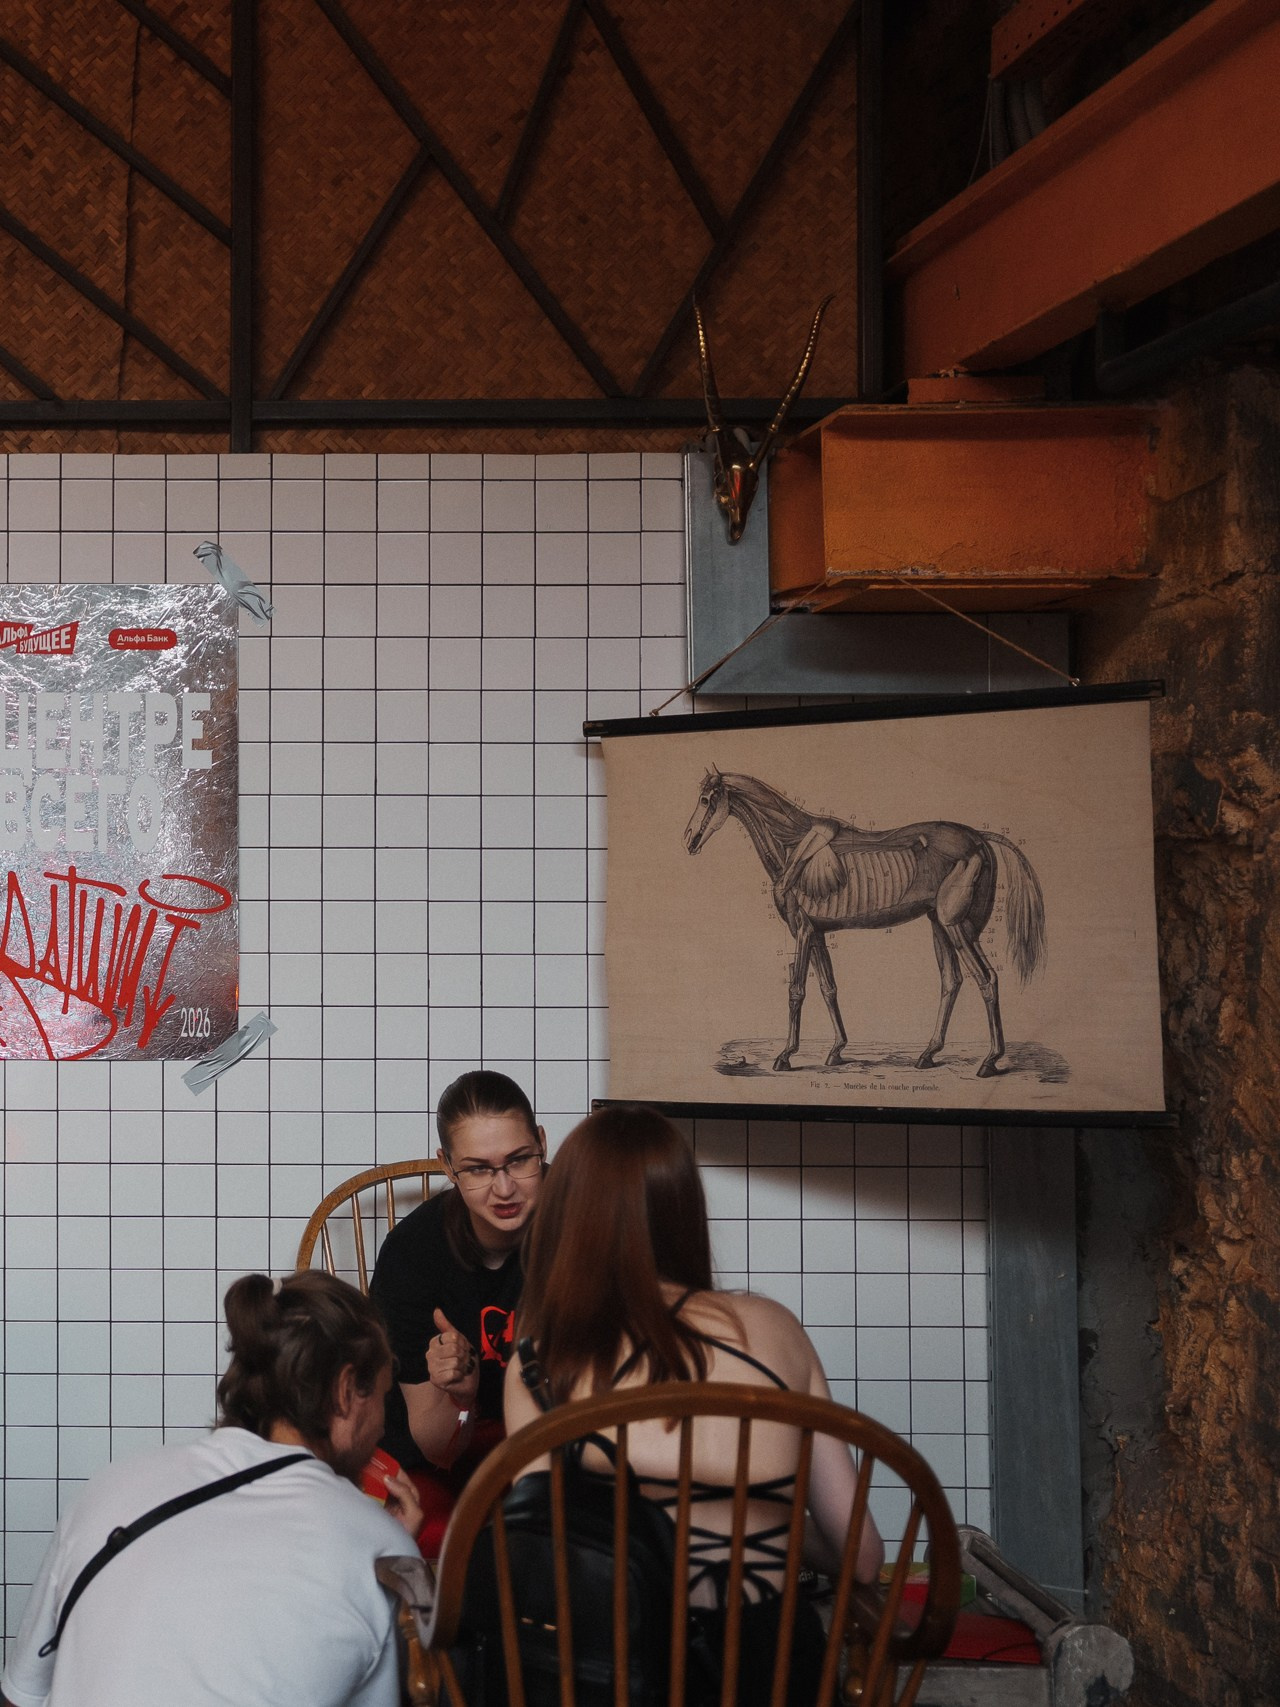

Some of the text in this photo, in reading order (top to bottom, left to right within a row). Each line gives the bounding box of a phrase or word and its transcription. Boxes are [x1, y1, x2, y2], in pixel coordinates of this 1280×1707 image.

[19, 627, 72, 653] БУДУЩЕЕ
[117, 634, 169, 645] Альфа Банк
[180, 1007, 210, 1038] 2026
[879, 1083, 886, 1091] la
[888, 1083, 910, 1091] couche
